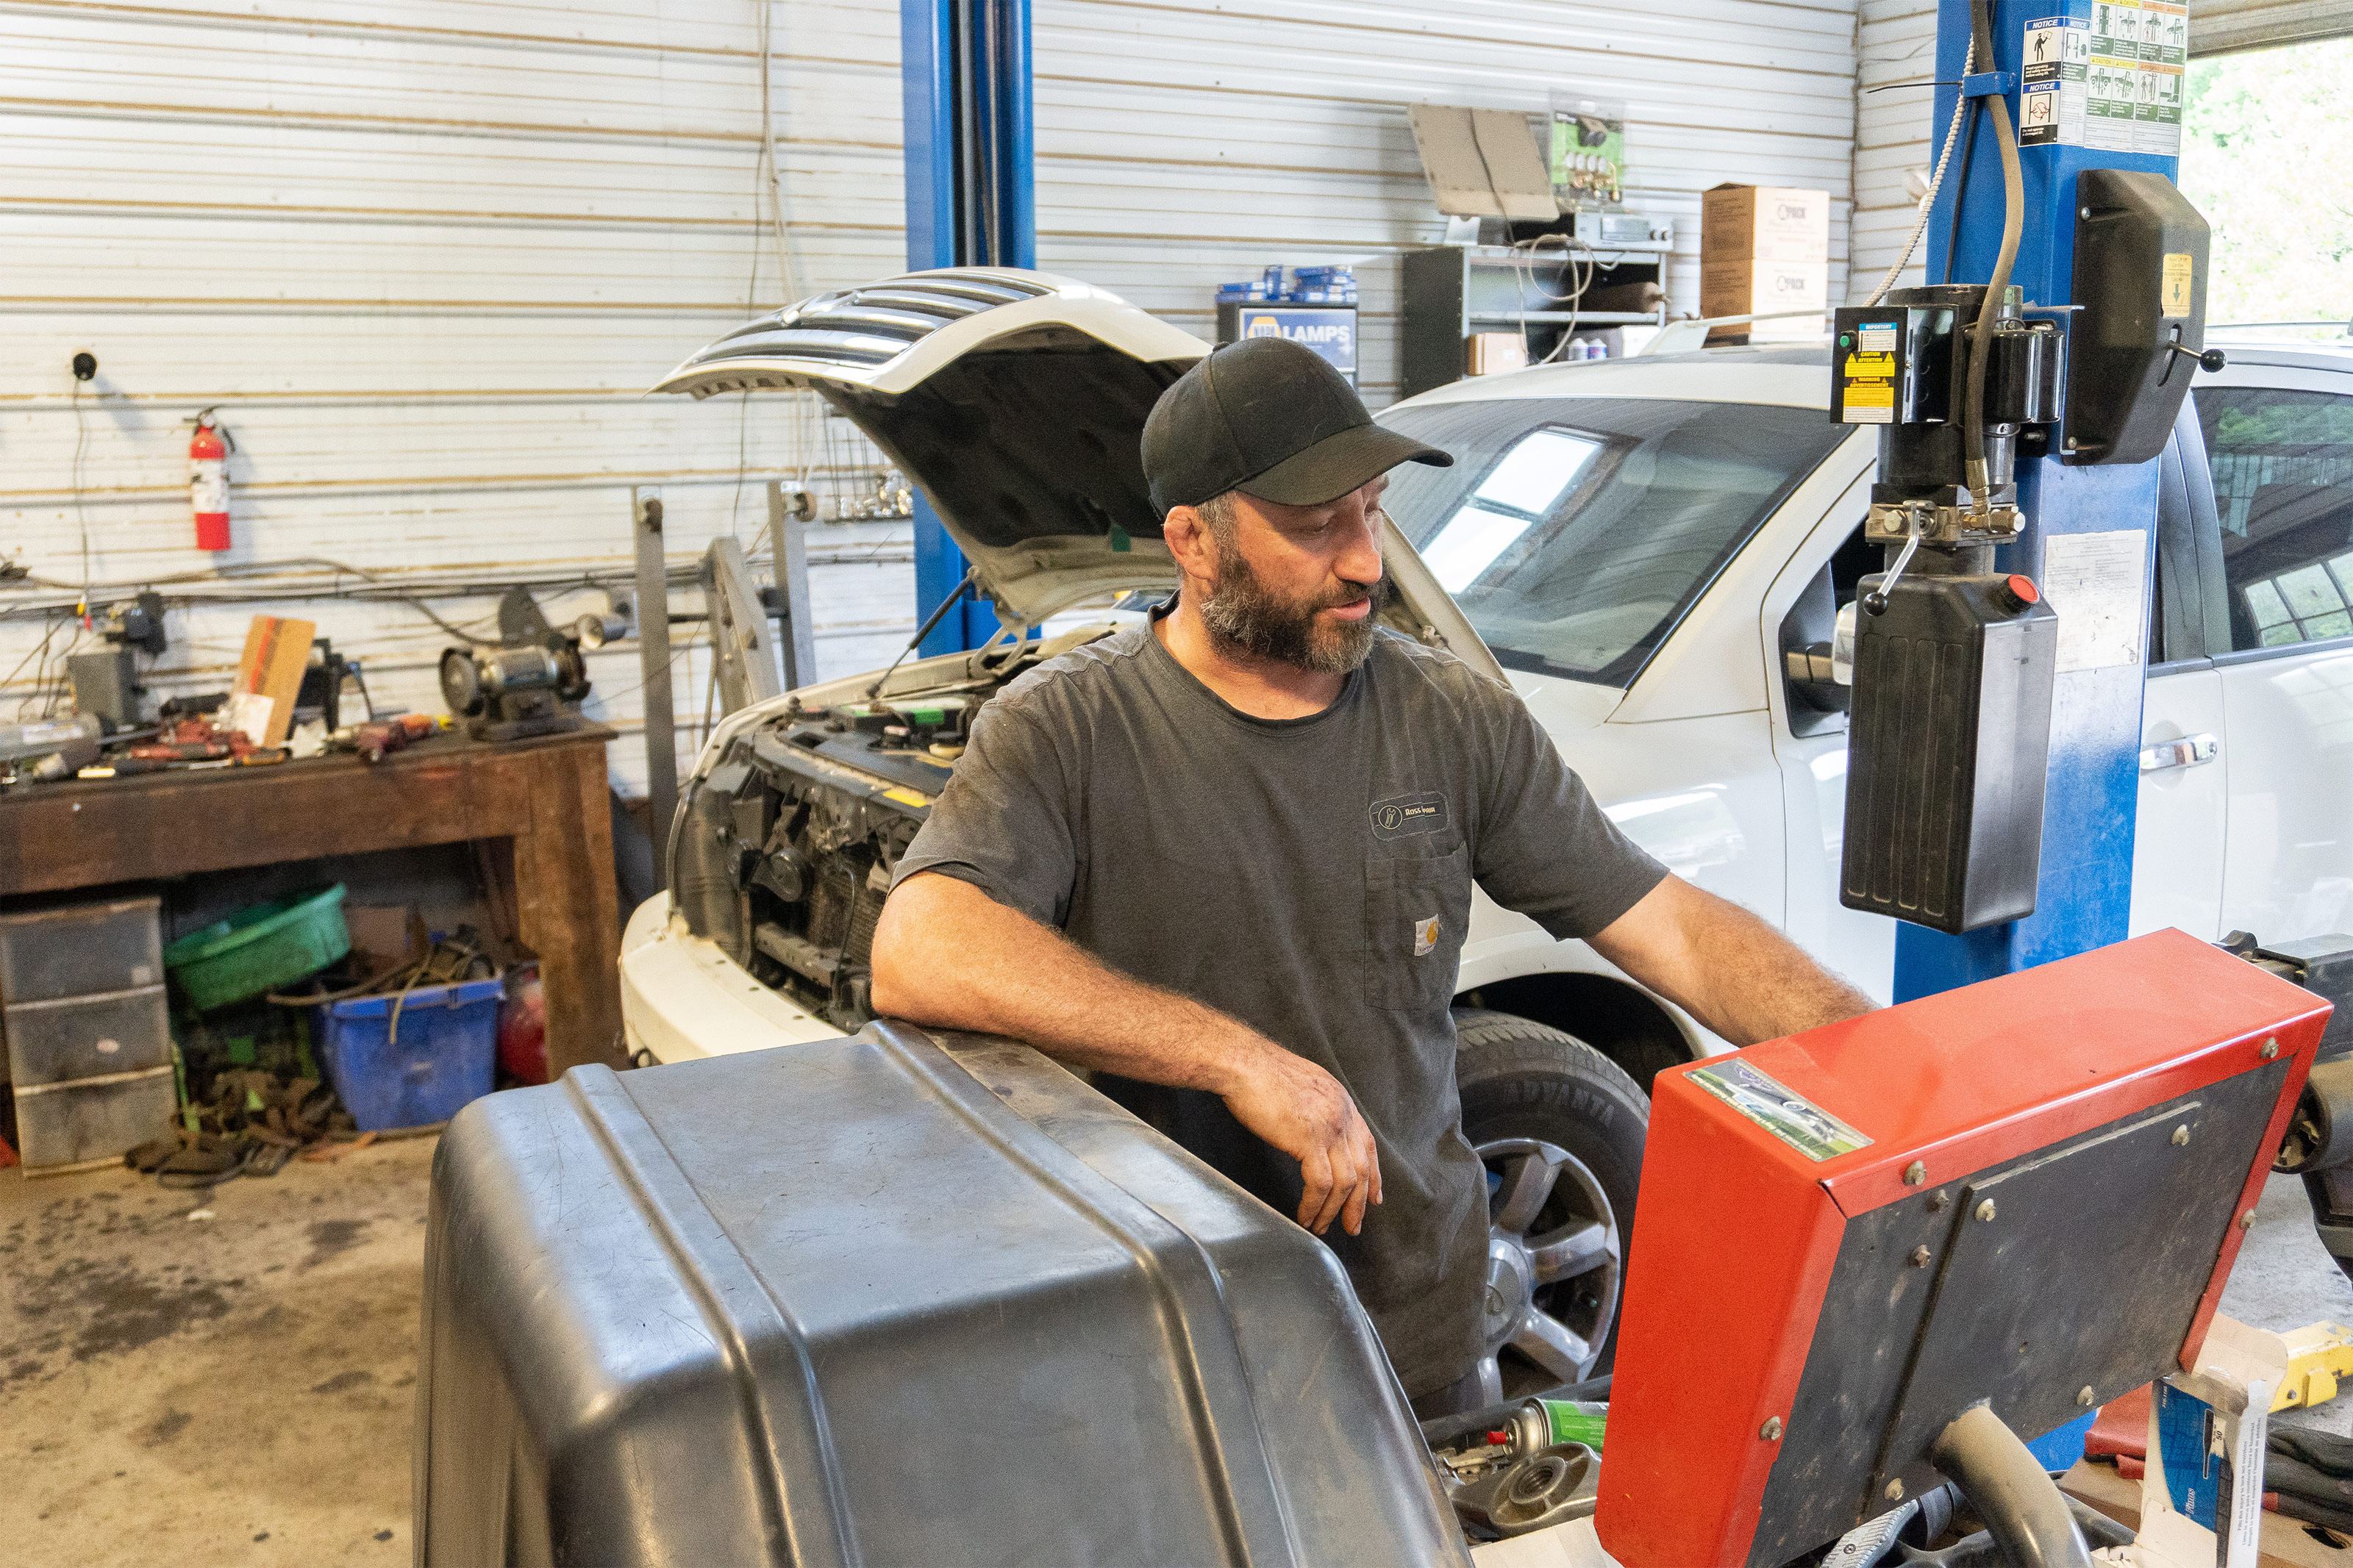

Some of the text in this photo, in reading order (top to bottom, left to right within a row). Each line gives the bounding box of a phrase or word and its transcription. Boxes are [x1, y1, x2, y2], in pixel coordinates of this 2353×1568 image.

[2032, 19, 2059, 29] NOTICE
[2069, 21, 2087, 29] NOTICE
[2029, 82, 2056, 92] NOTICE
[1282, 325, 1351, 343] LAMPS
[1504, 1081, 1615, 1128] ADVANTA
[2215, 1430, 2222, 1439] 50
